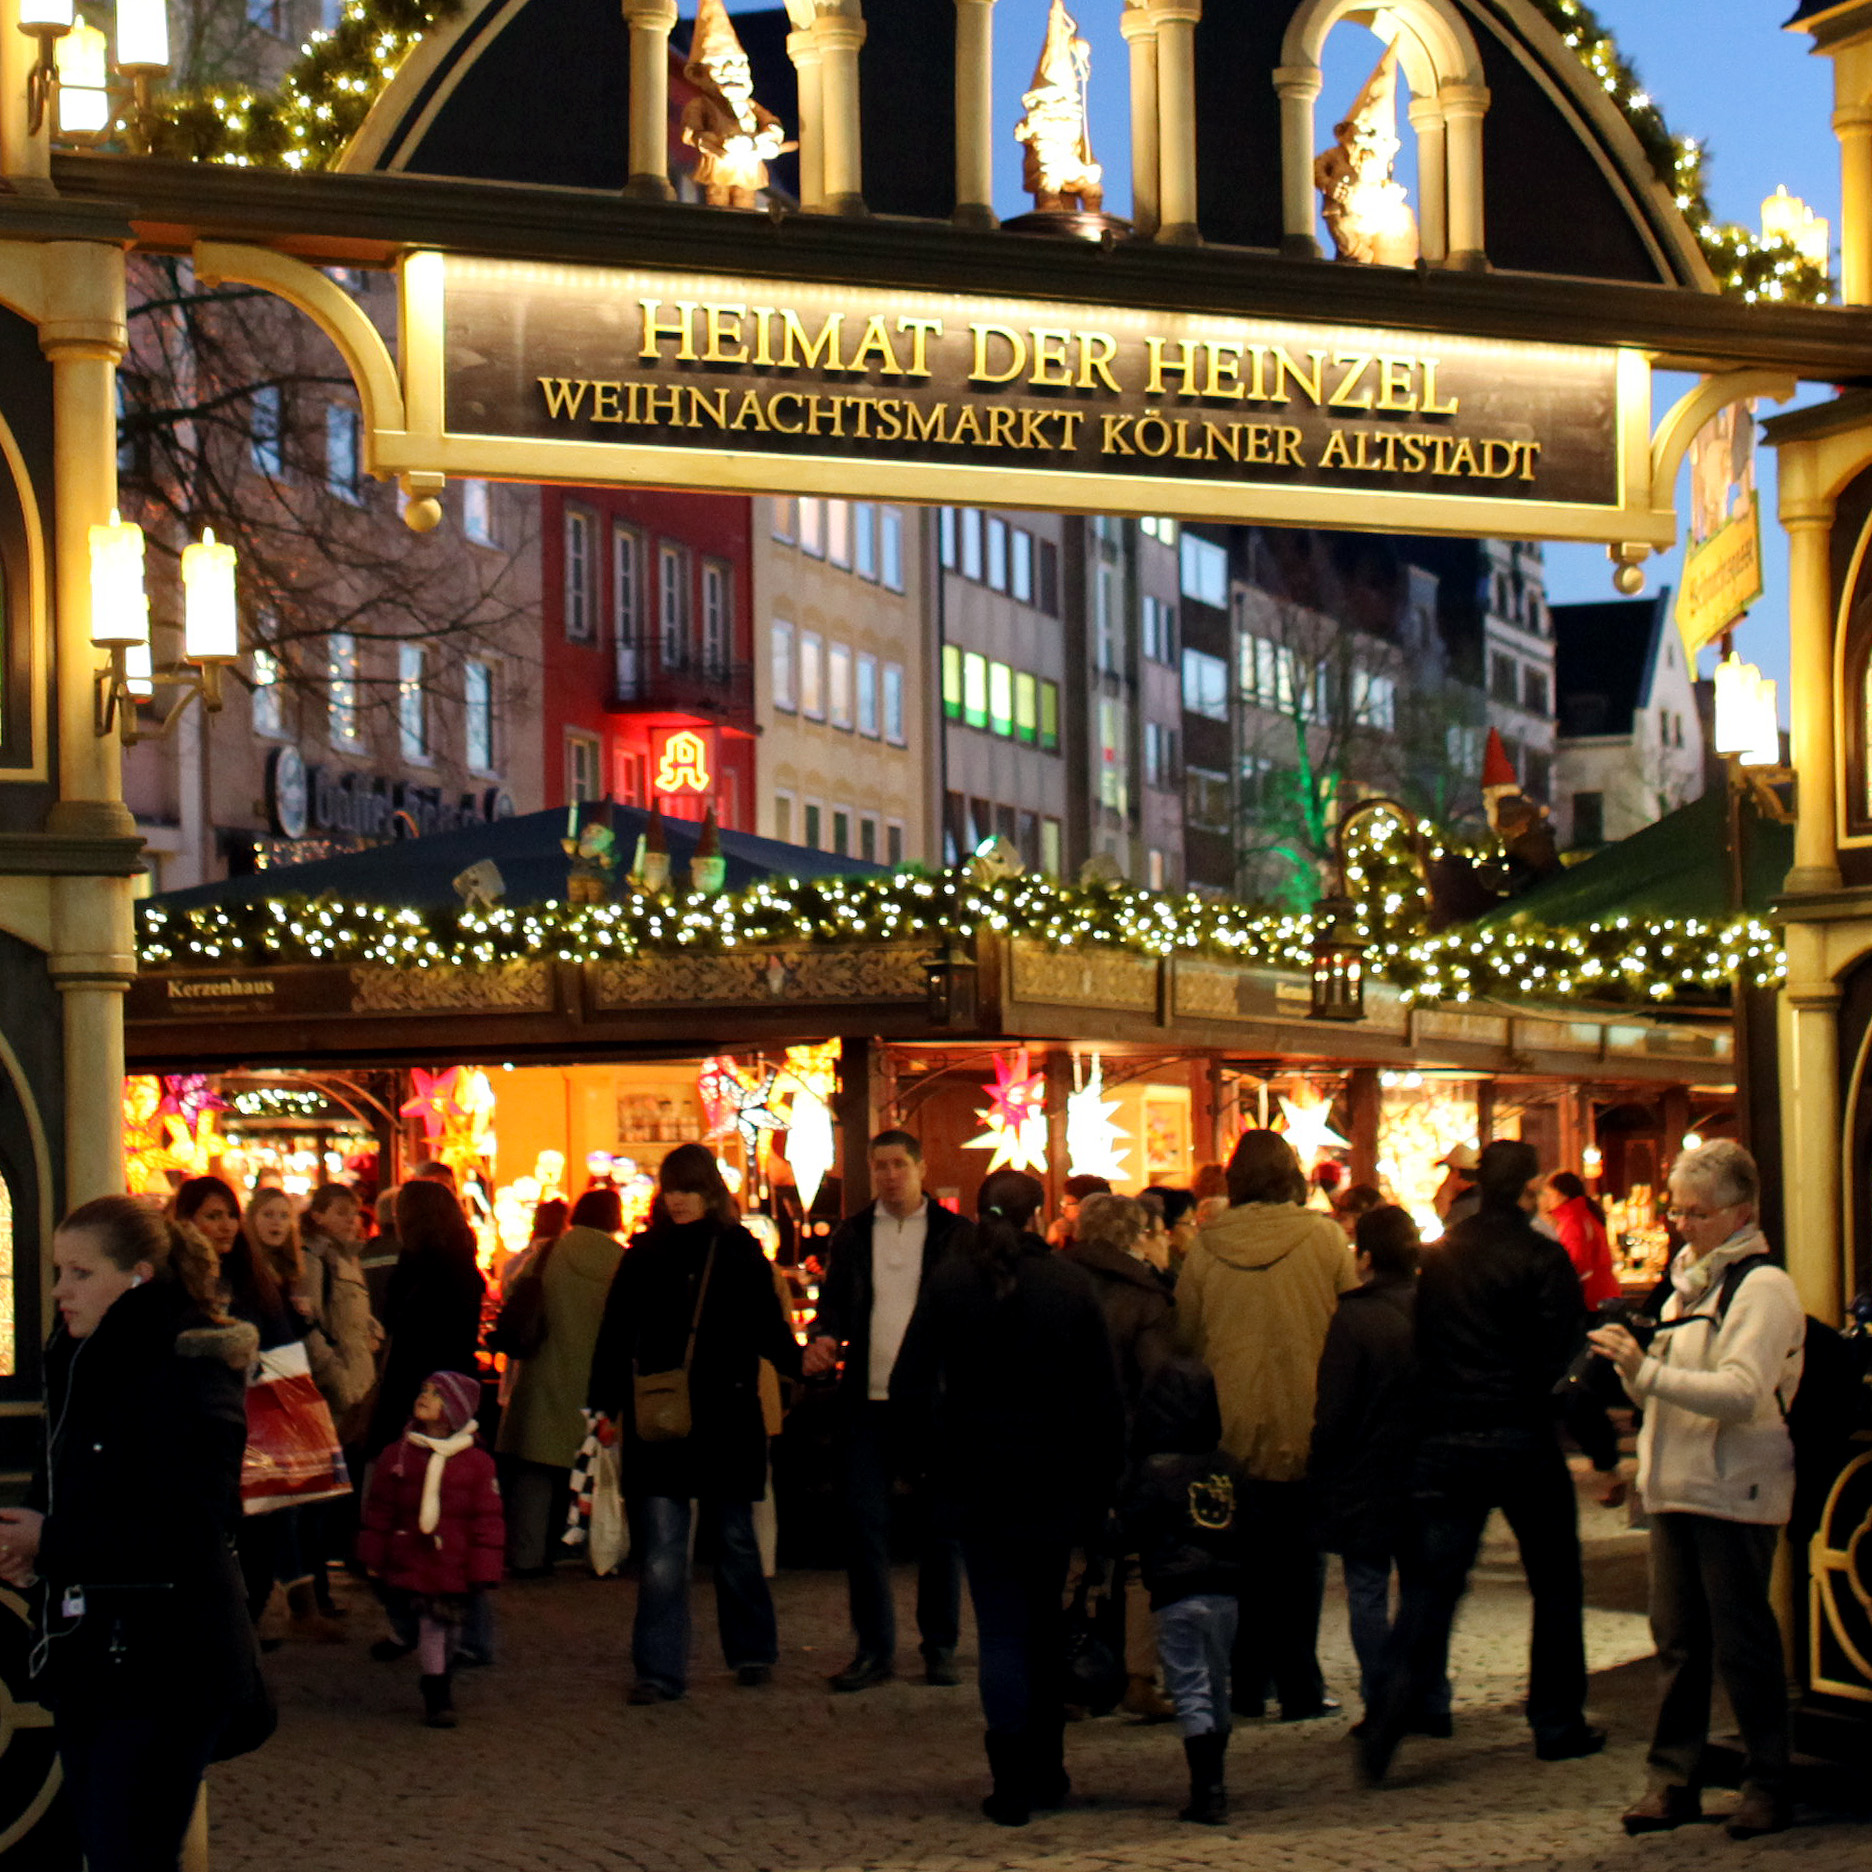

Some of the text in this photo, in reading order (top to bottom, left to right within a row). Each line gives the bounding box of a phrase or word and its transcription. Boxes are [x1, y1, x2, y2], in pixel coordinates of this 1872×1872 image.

[638, 297, 1460, 415] HEIMAT DER HEINZEL
[536, 376, 1542, 482] WEIHNACHTSMARKT KÖLNER ALTSTADT
[167, 977, 275, 998] Kerzenhaus
